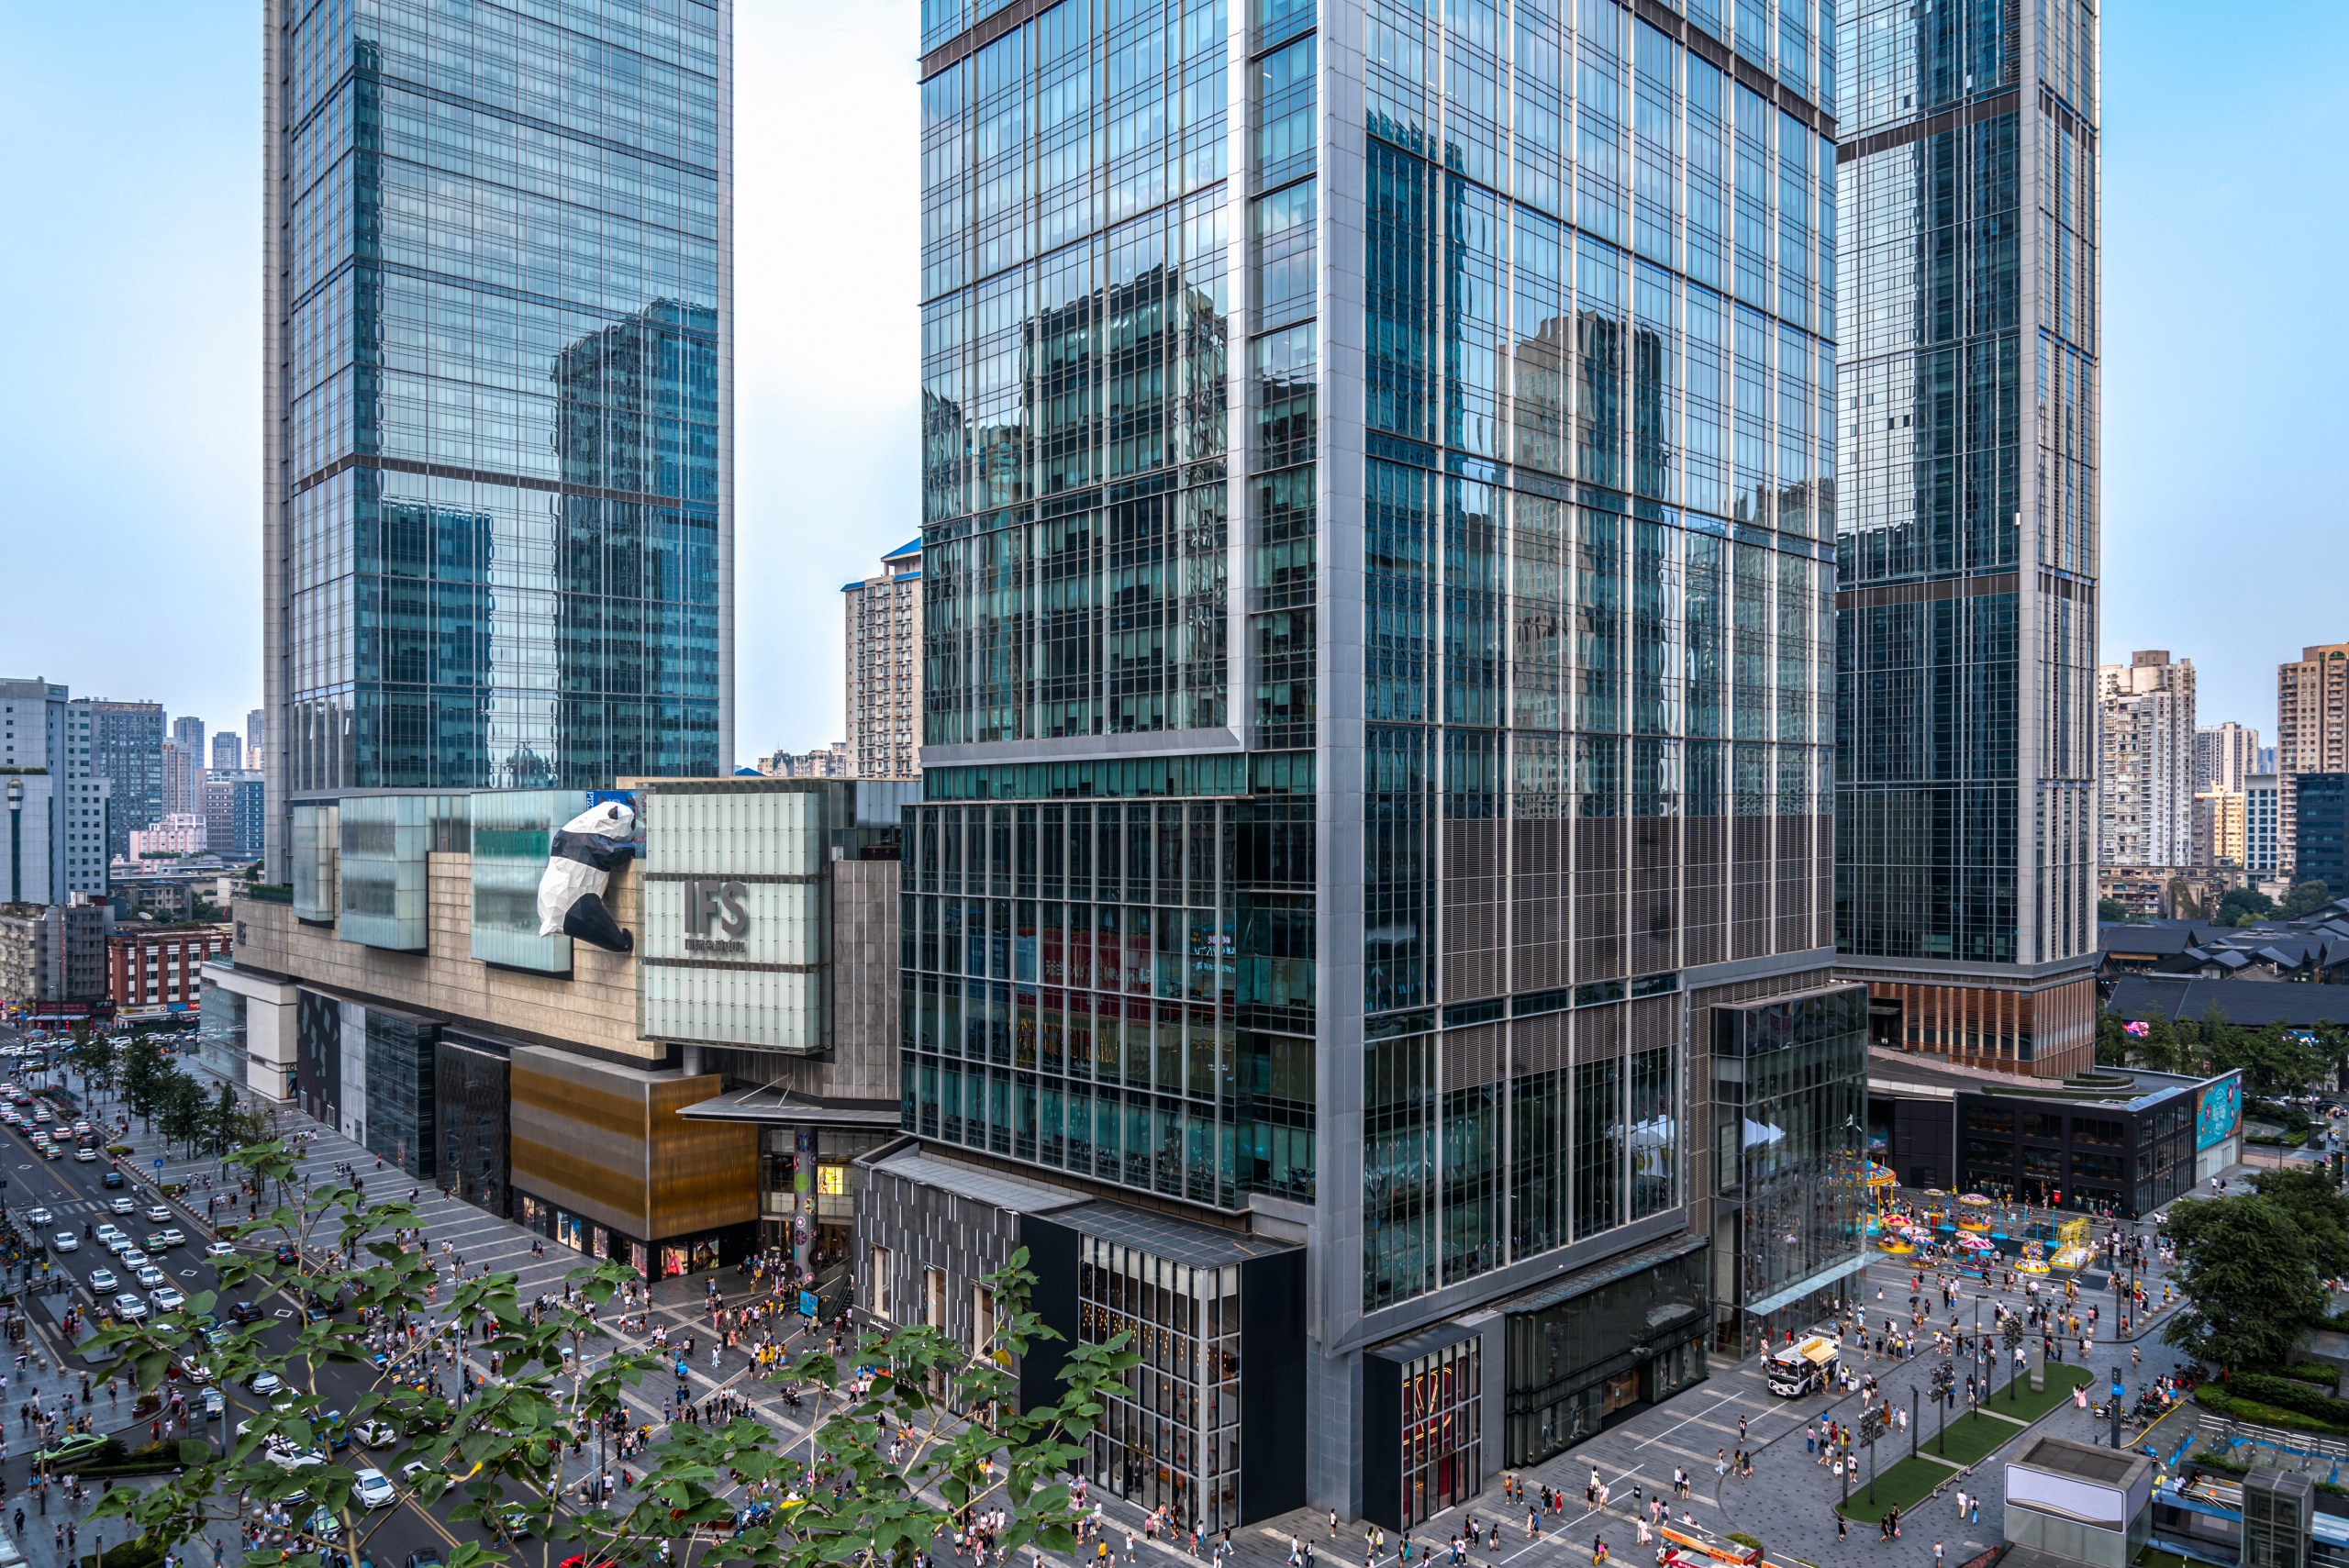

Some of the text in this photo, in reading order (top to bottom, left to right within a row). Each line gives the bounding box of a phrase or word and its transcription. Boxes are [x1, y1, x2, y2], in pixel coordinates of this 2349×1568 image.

[685, 880, 746, 935] IFS
[685, 939, 745, 952] 国际金融中心
